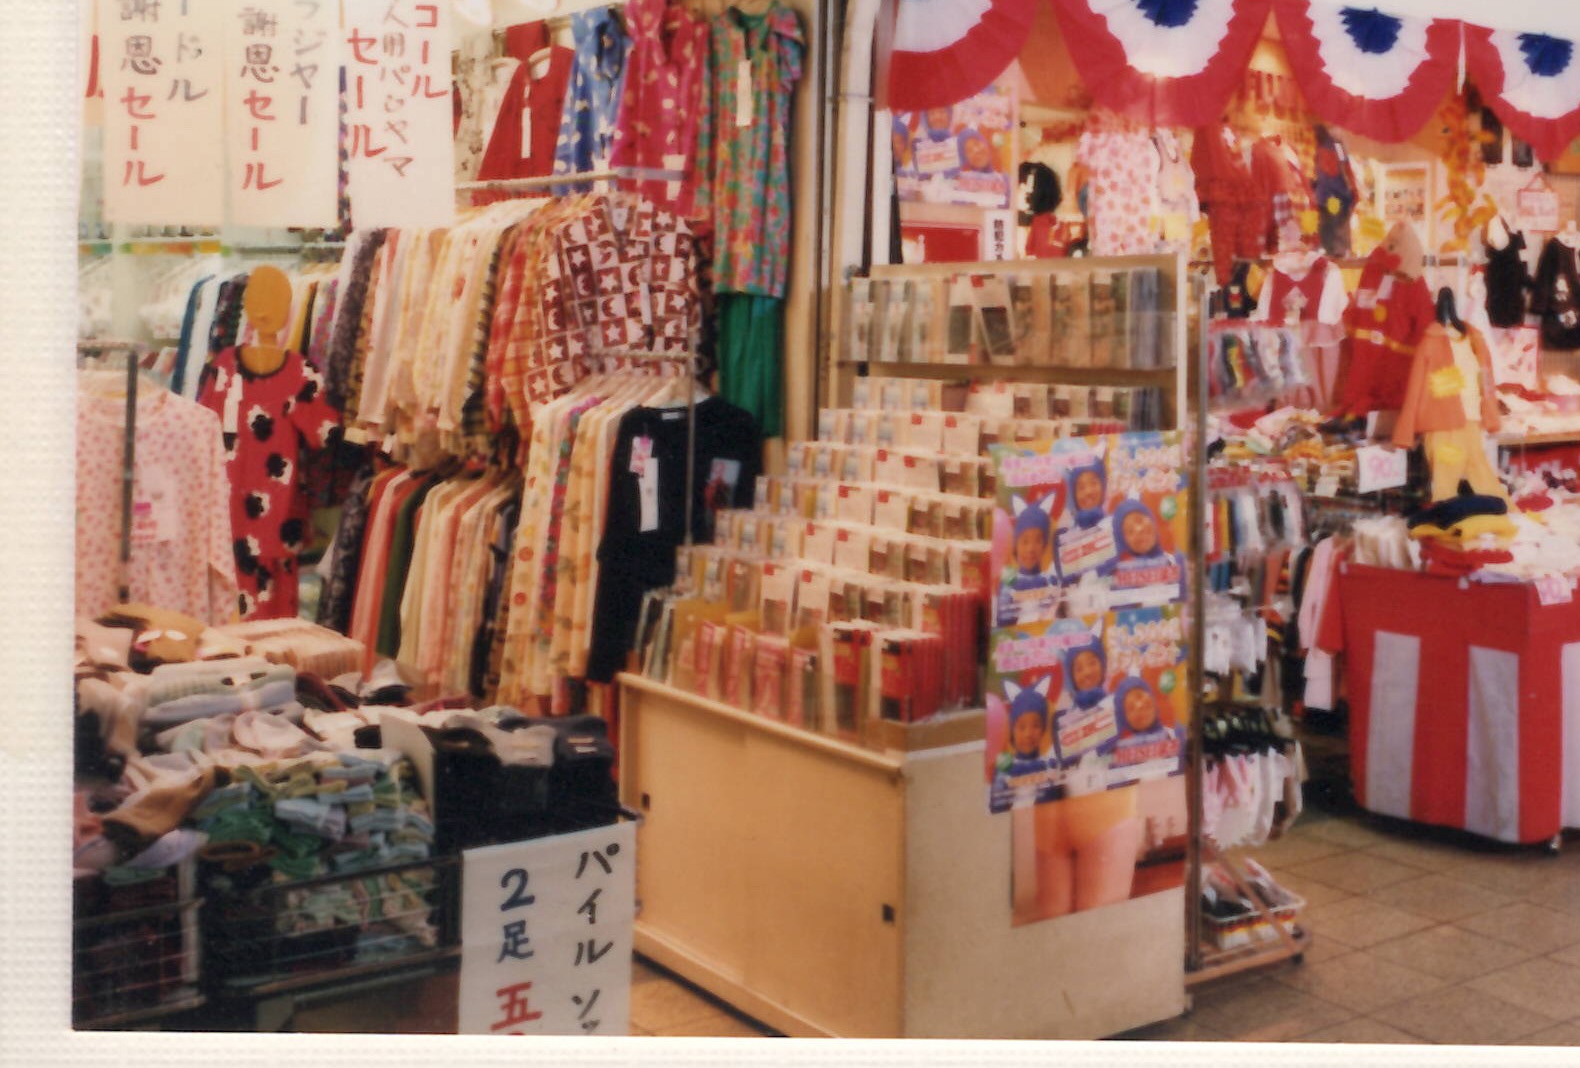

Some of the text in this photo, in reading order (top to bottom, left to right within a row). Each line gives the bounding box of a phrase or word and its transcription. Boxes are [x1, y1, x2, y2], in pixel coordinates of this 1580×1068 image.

[237, 6, 285, 191] 謝恩セール
[346, 27, 389, 159] セール
